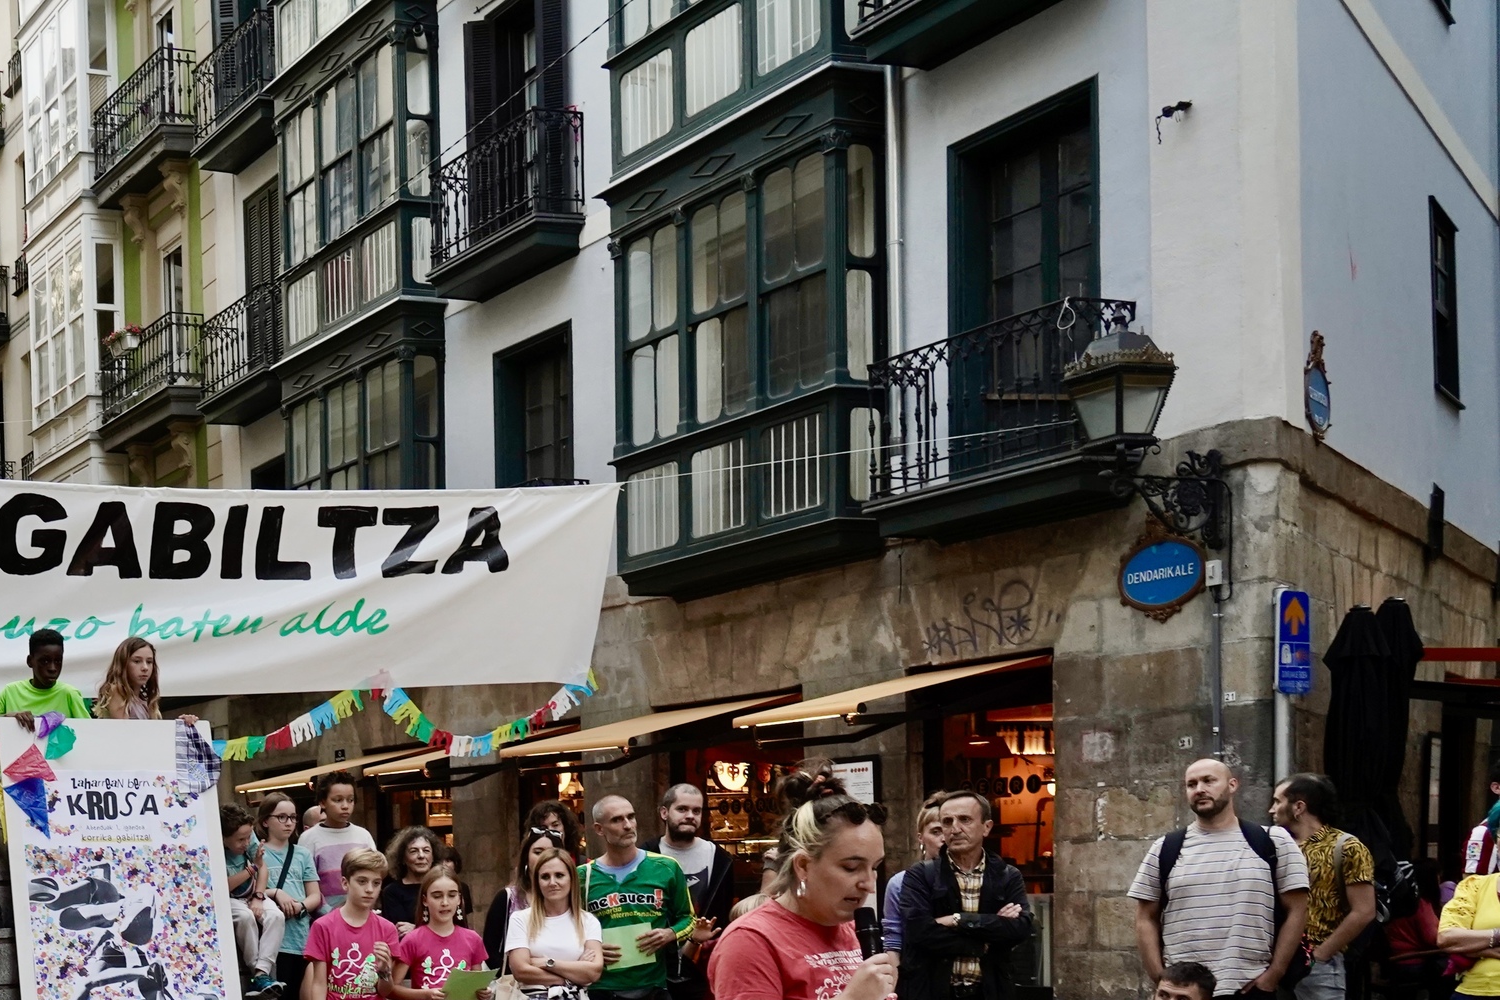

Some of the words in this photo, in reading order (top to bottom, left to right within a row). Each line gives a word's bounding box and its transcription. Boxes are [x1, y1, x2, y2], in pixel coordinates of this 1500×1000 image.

[1127, 562, 1195, 585] DENDARIKALE
[128, 603, 278, 643] baten
[279, 597, 390, 637] alde
[66, 791, 159, 820] KROSA
[81, 833, 113, 842] korrika
